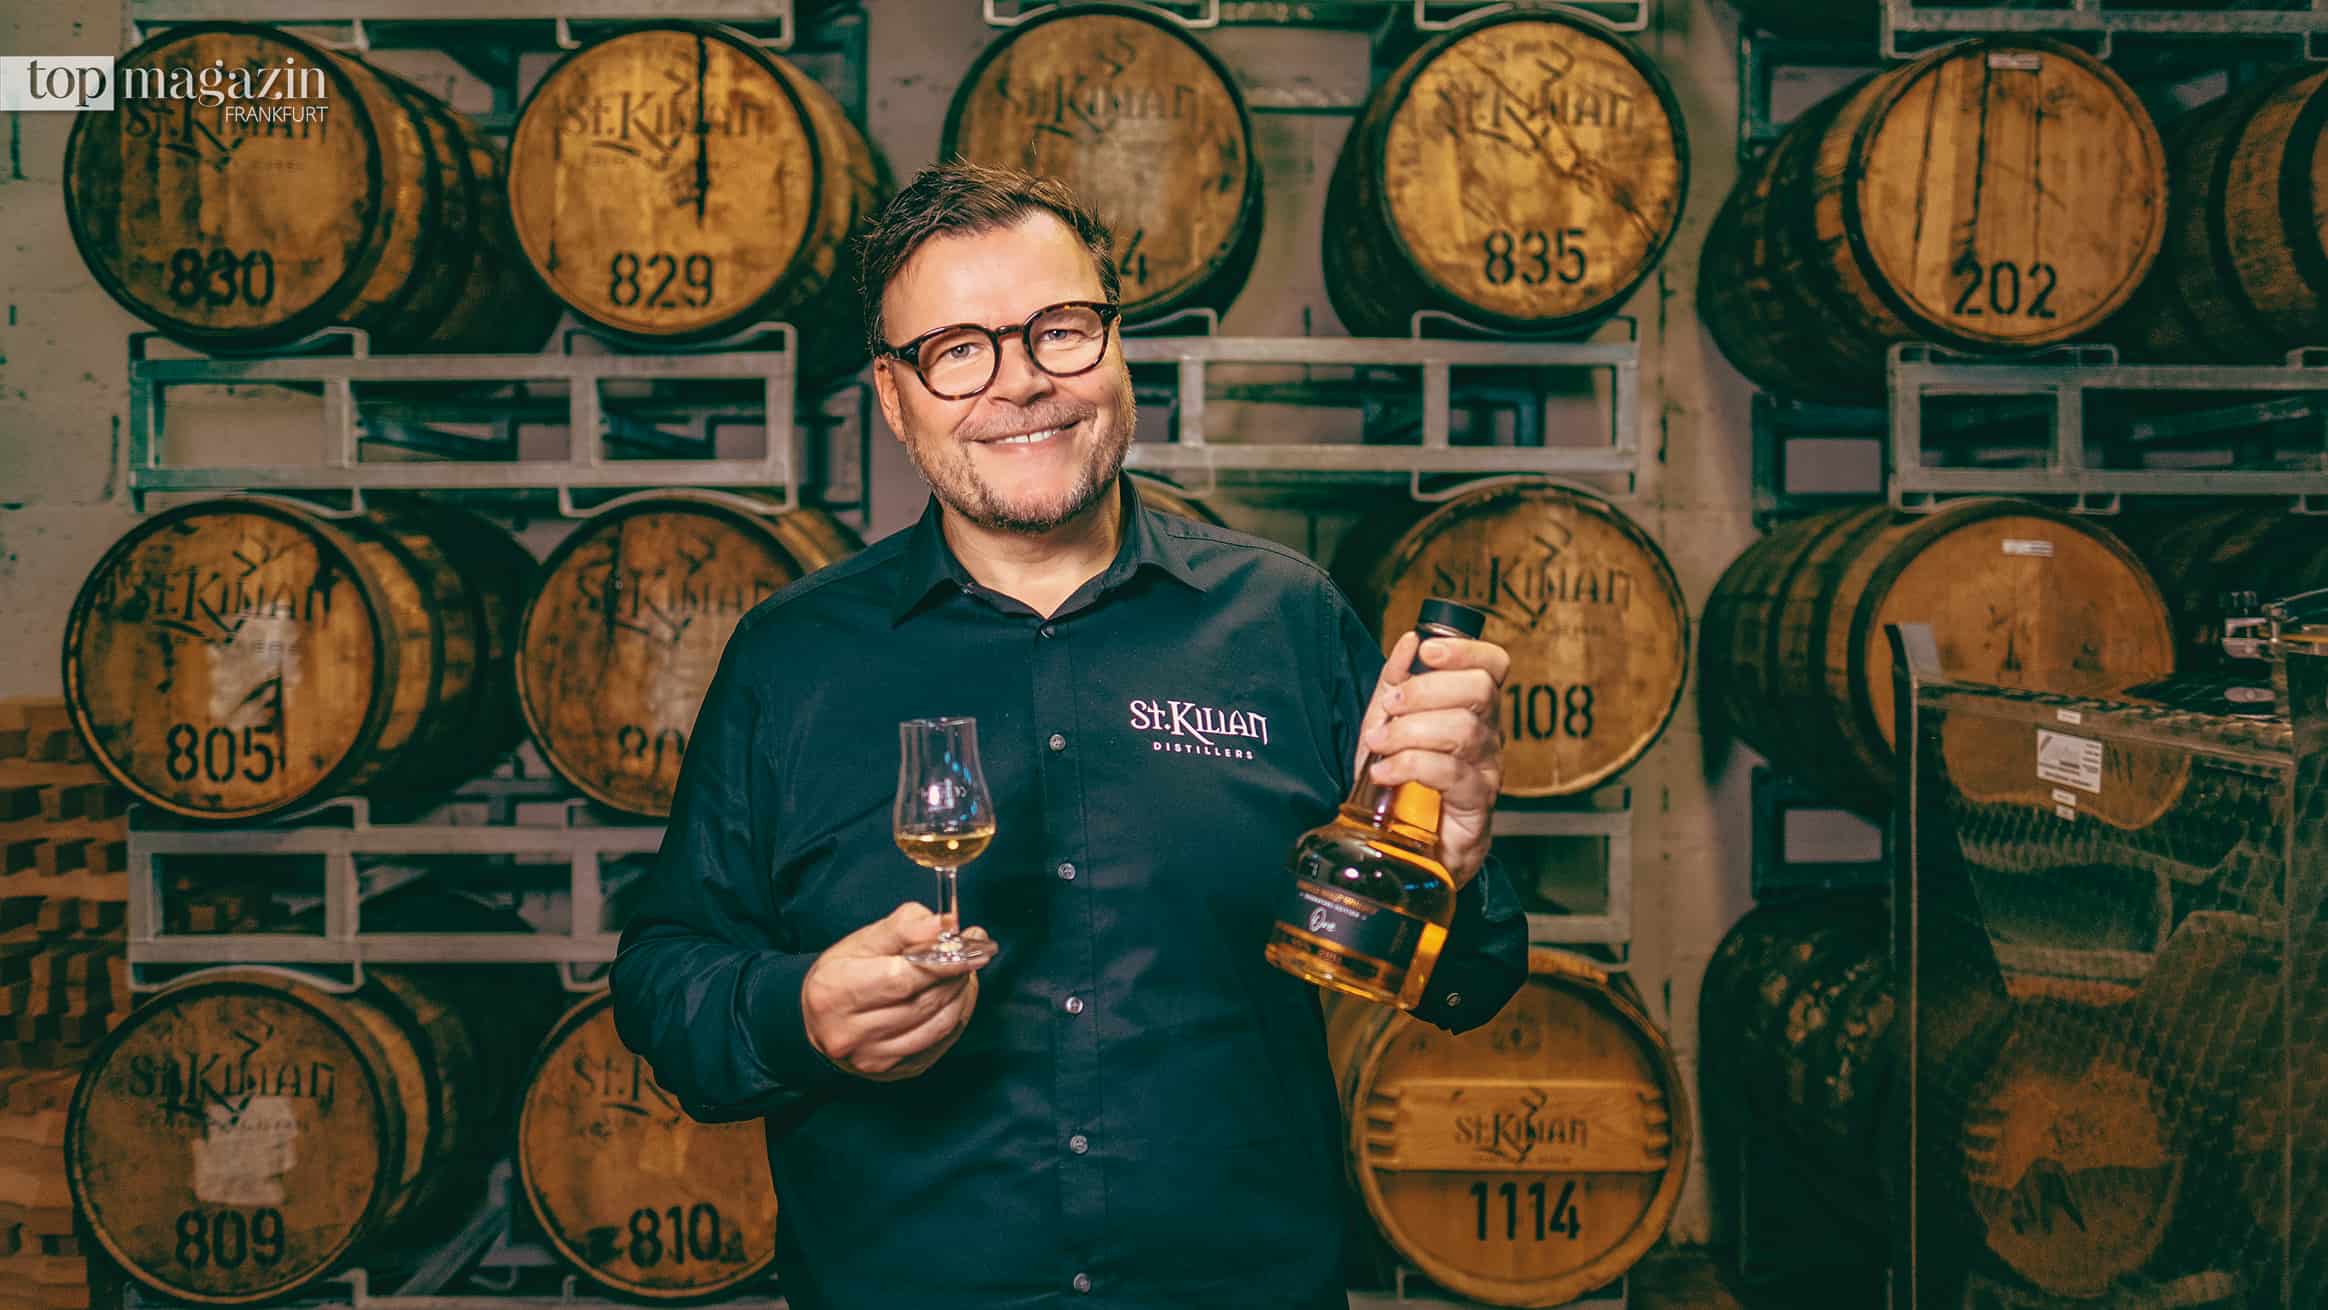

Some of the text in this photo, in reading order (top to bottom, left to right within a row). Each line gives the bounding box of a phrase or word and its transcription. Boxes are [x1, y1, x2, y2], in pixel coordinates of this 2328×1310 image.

[171, 248, 275, 307] 830
[609, 252, 713, 308] 829
[1484, 228, 1587, 285] 835
[1952, 261, 2057, 318] 202
[166, 723, 275, 783] 805
[1153, 741, 1254, 760] DISTILLERS
[175, 1208, 285, 1269] 809
[629, 1202, 721, 1268] 810
[1470, 1181, 1581, 1241] 1114
